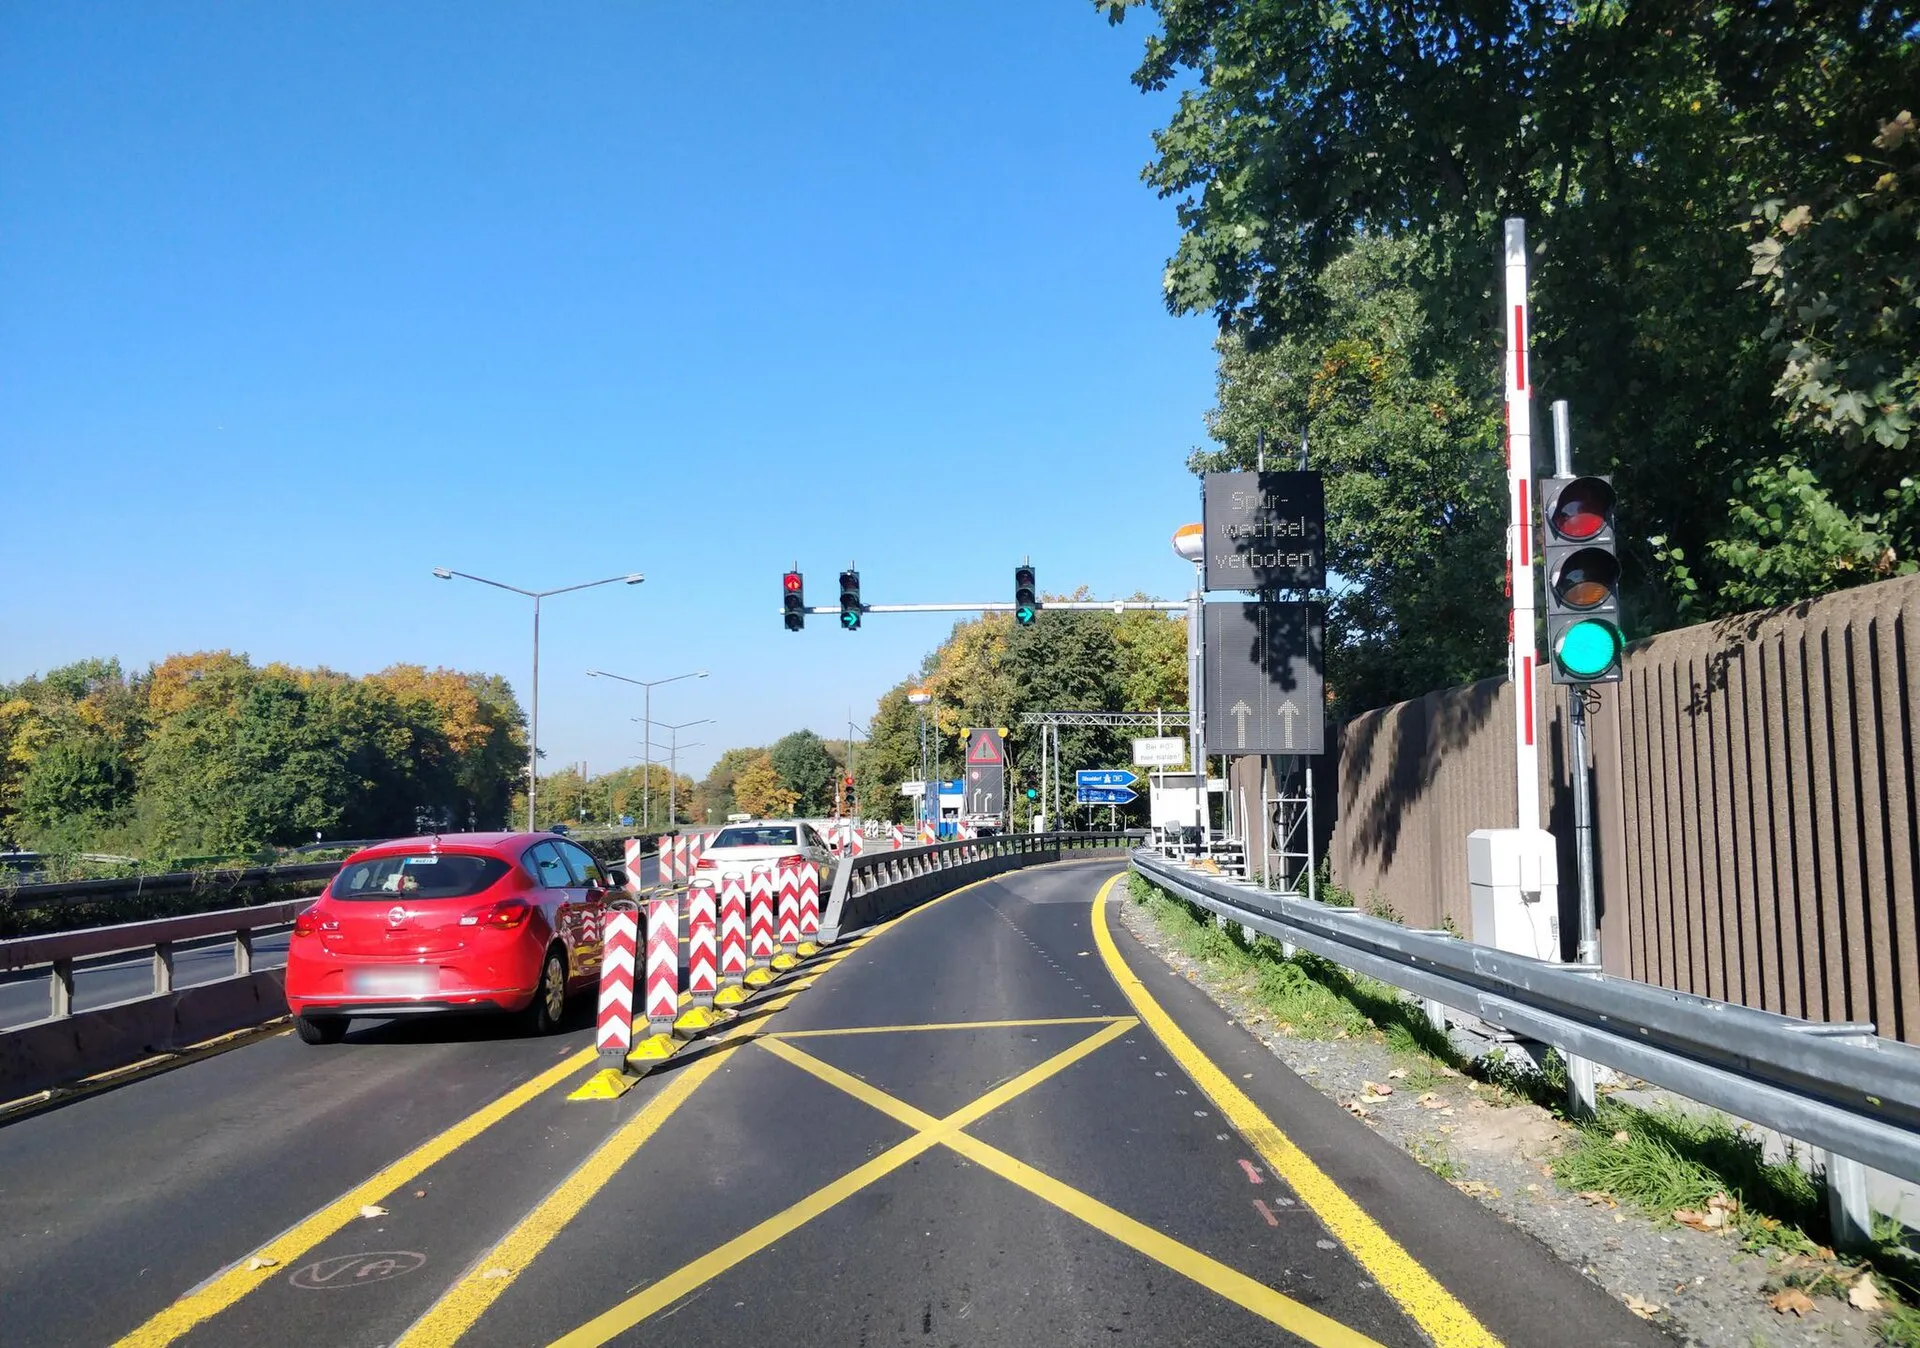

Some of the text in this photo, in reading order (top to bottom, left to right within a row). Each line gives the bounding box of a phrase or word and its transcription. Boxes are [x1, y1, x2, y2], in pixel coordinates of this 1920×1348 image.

[1232, 491, 1289, 517] Spur-
[1221, 515, 1305, 538] wechsel
[1215, 547, 1312, 569] verboten
